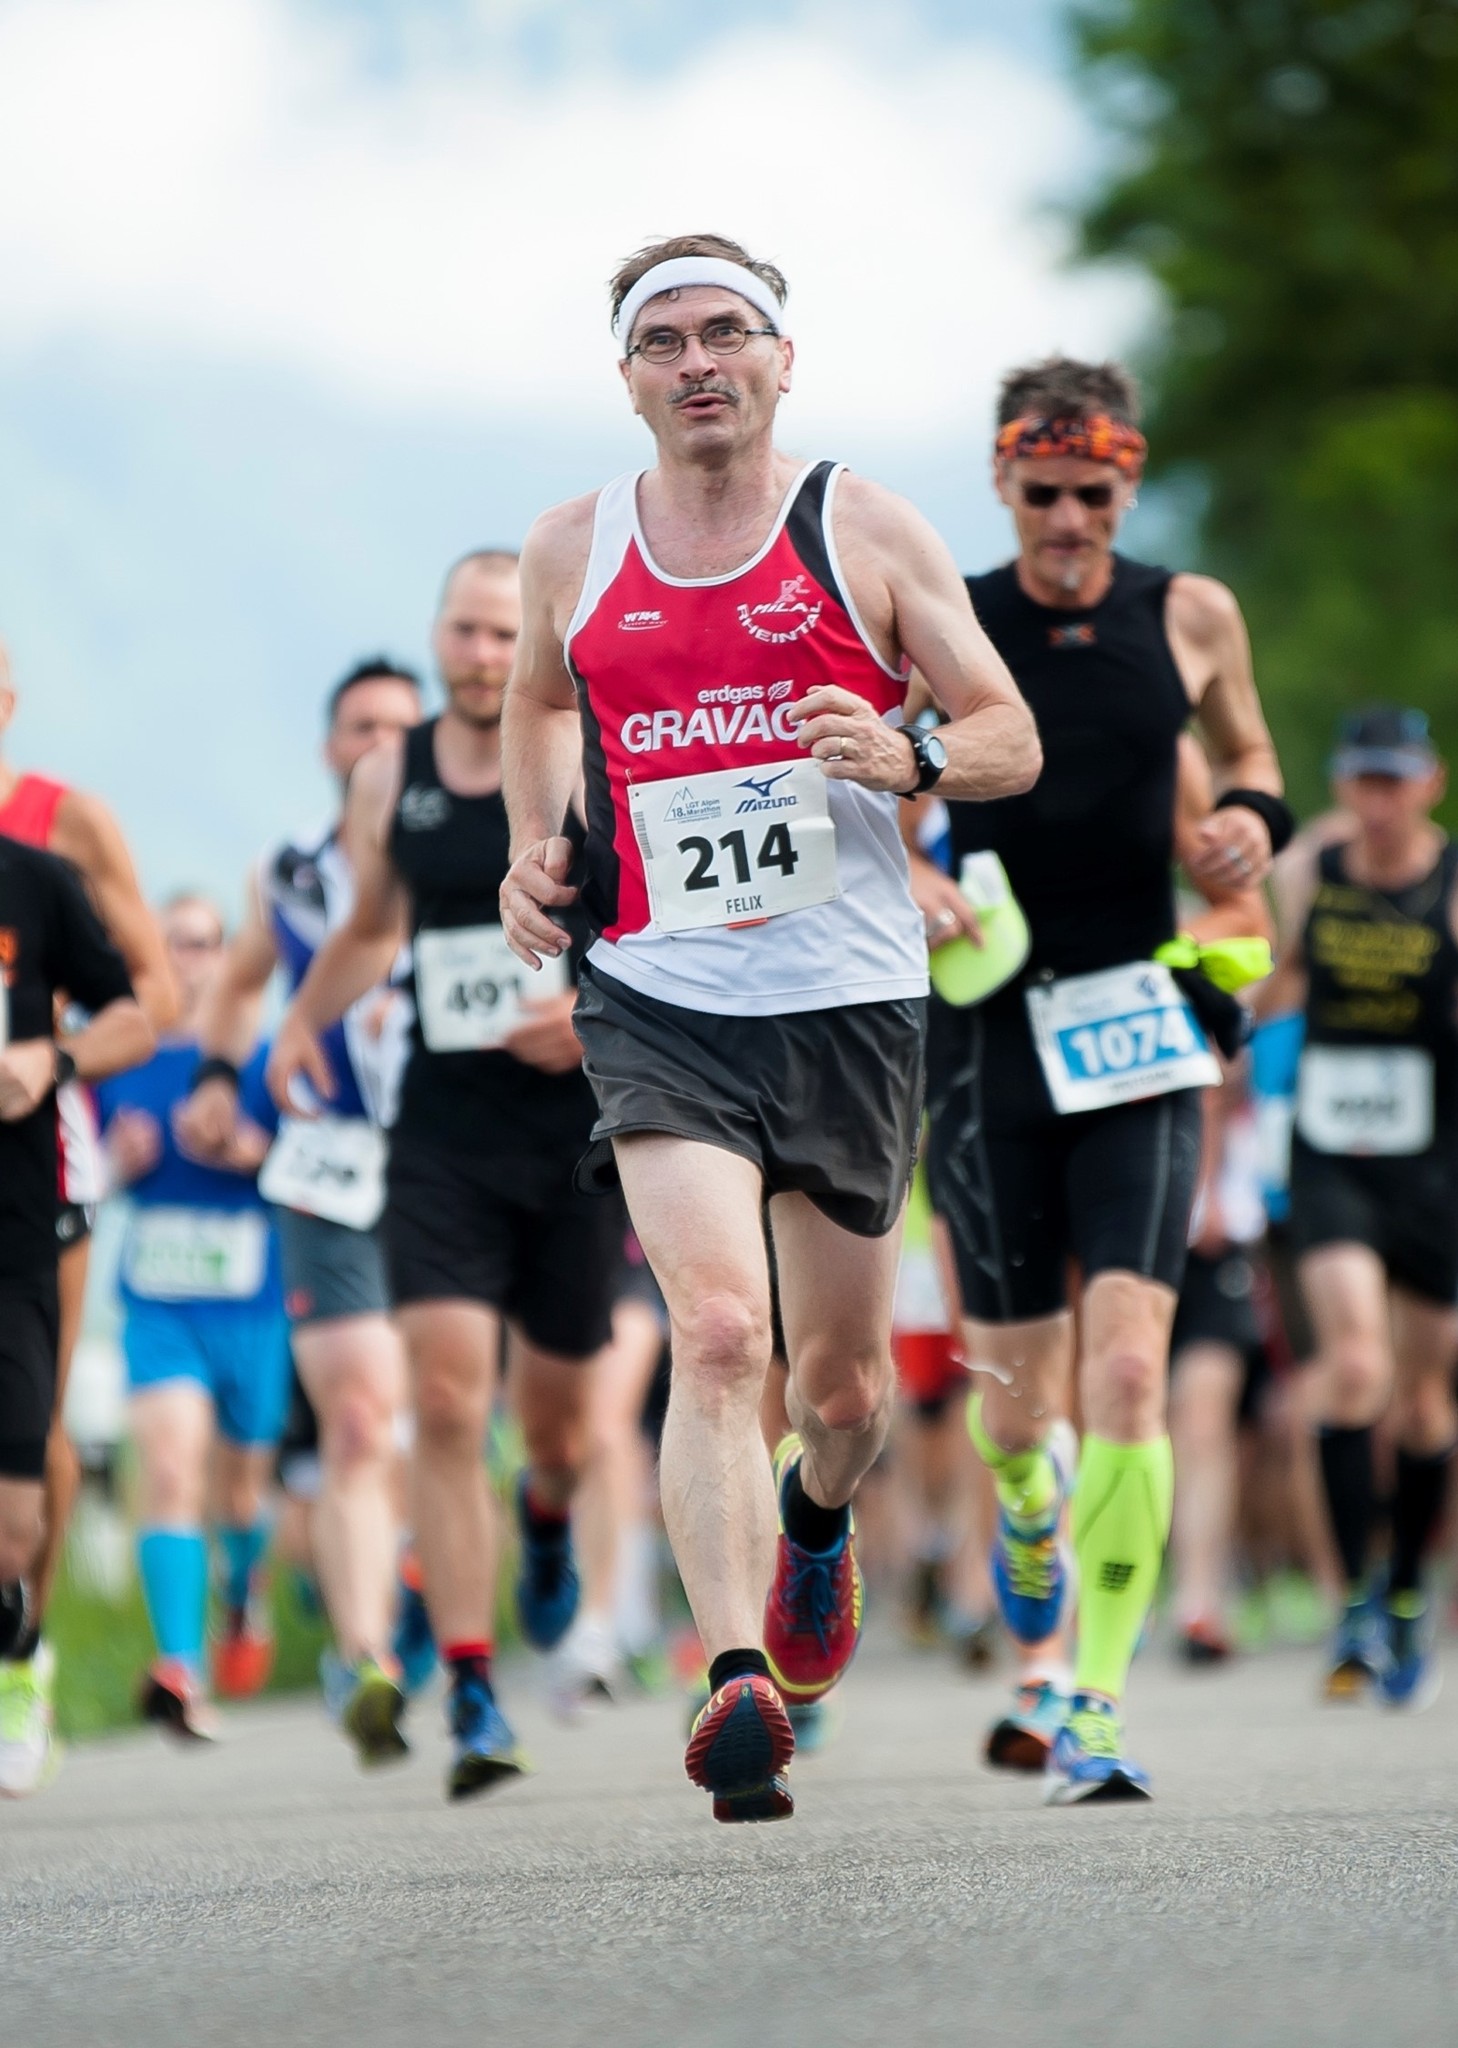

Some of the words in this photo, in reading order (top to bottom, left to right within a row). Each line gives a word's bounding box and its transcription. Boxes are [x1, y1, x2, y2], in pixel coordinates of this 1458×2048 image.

[697, 684, 764, 704] erdgas
[687, 806, 721, 815] Marathon
[676, 822, 799, 892] 214
[726, 895, 763, 914] FELIX
[1069, 1007, 1196, 1077] 1074
